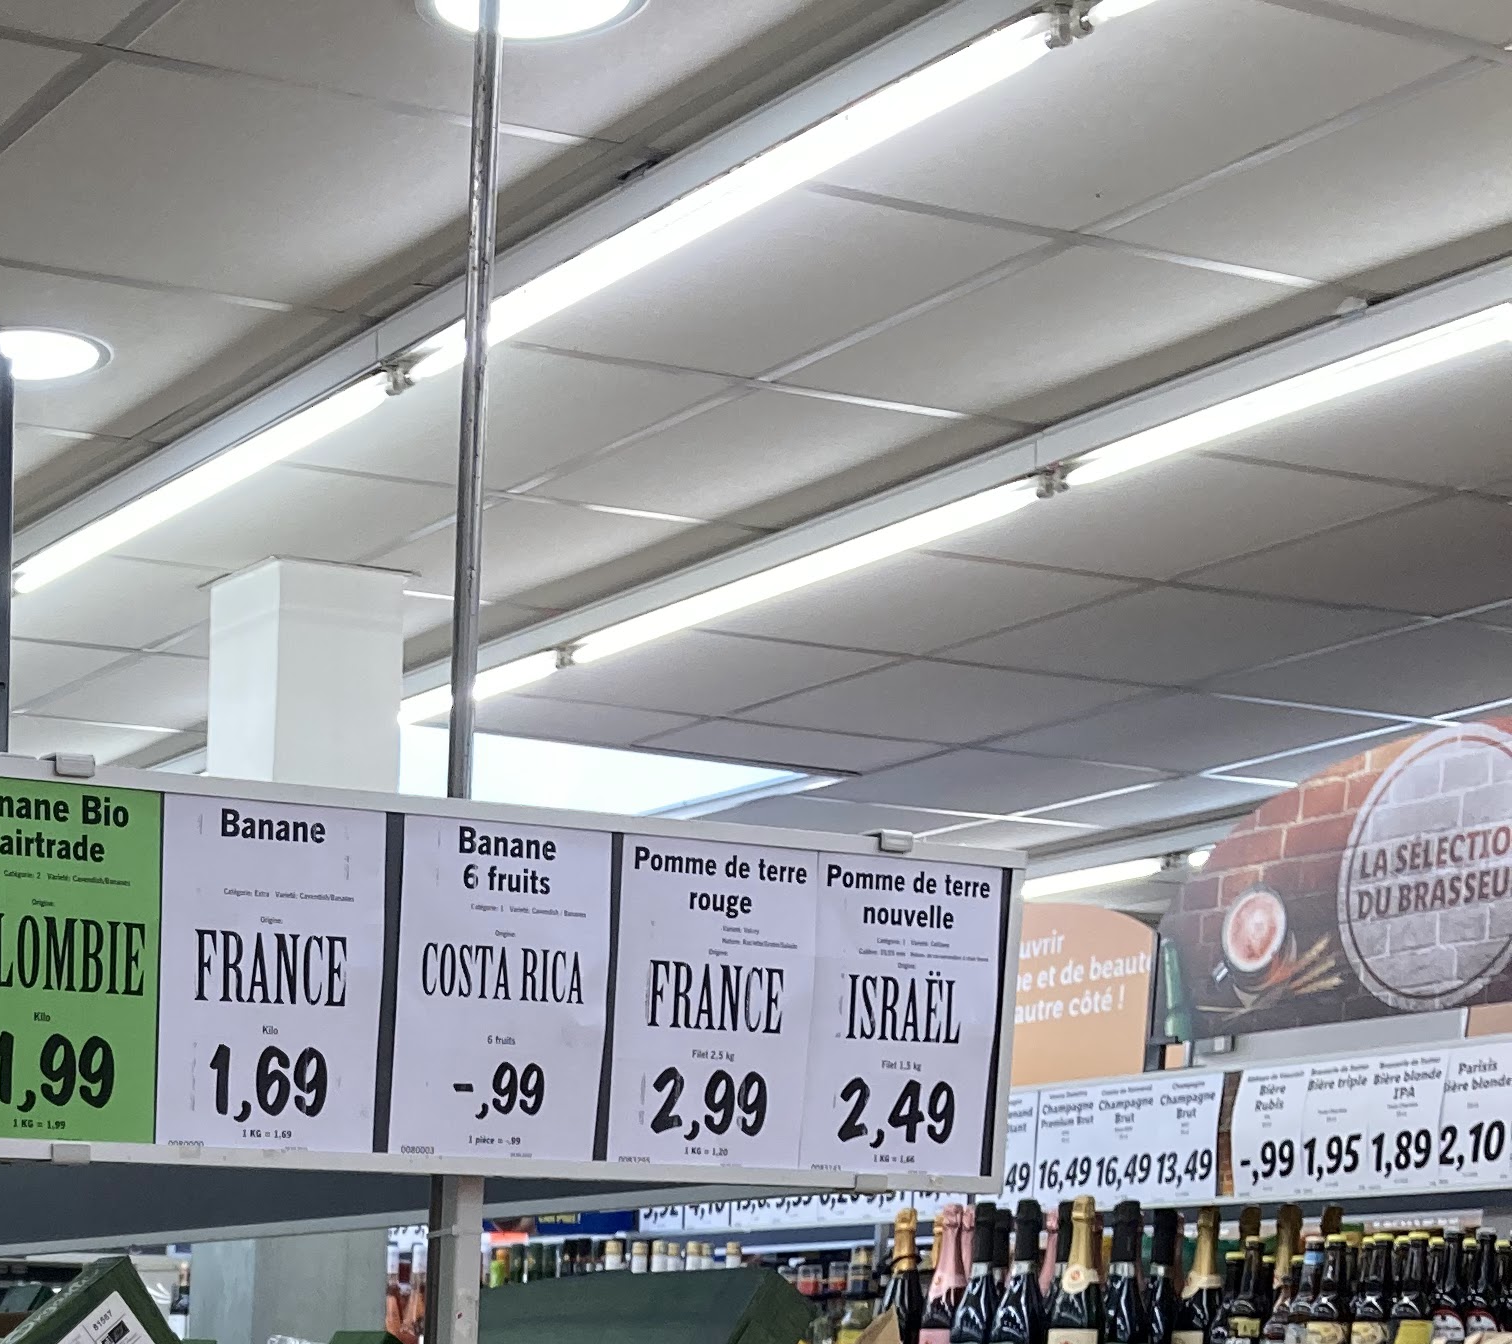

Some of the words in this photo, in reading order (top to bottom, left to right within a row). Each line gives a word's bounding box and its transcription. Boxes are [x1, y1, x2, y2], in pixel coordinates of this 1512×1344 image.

[82, 794, 130, 828] Bio
[221, 807, 326, 844] Banane
[458, 825, 557, 861] Banane
[463, 863, 479, 890] 6
[487, 865, 551, 895] fruits
[634, 845, 717, 877] Pomme
[724, 854, 751, 879] de
[758, 858, 808, 885] terre
[826, 863, 906, 892] Pomme
[913, 870, 937, 895] de
[944, 874, 991, 899] terre
[1360, 848, 1388, 880] LA
[689, 891, 753, 919] rouge
[863, 904, 955, 929] nouvelle
[1357, 886, 1389, 920] DU
[194, 928, 347, 1007] FRANCE
[422, 942, 512, 1001] COSTA
[519, 947, 585, 1005] RICA
[1037, 968, 1055, 989] et
[1060, 962, 1084, 987] de
[647, 959, 785, 1034] FRANCE
[845, 970, 961, 1044] ISRAËL
[1014, 1001, 1062, 1025] autre
[1069, 985, 1113, 1016] côté
[33, 1011, 51, 1023] Kilo
[262, 1025, 279, 1035] Kilo
[209, 1043, 328, 1123] 1,69
[452, 1061, 545, 1120] -,99
[1258, 1083, 1286, 1097] Bière
[1307, 1076, 1335, 1092] Bière
[1337, 1074, 1369, 1089] triple
[1373, 1072, 1401, 1087] Bière
[1403, 1068, 1442, 1083] blonde
[1393, 1086, 1416, 1099] IPA
[650, 1066, 768, 1141] 2,99
[837, 1076, 956, 1149] 2,49
[1042, 1101, 1095, 1116] Champagne
[1098, 1096, 1154, 1111] Champagne
[1159, 1092, 1216, 1106] Champagne
[1176, 1108, 1197, 1119] Brut
[1254, 1098, 1284, 1113] Rubis
[1115, 1112, 1135, 1124] Brut
[1240, 1140, 1295, 1186] -,99
[1302, 1133, 1362, 1182] 1,95
[1371, 1128, 1432, 1177] 1,89
[1439, 1120, 1505, 1172] 2,10
[1039, 1156, 1092, 1193] 16,49
[1096, 1153, 1152, 1191] 16,49
[1157, 1149, 1213, 1187] 13,49
